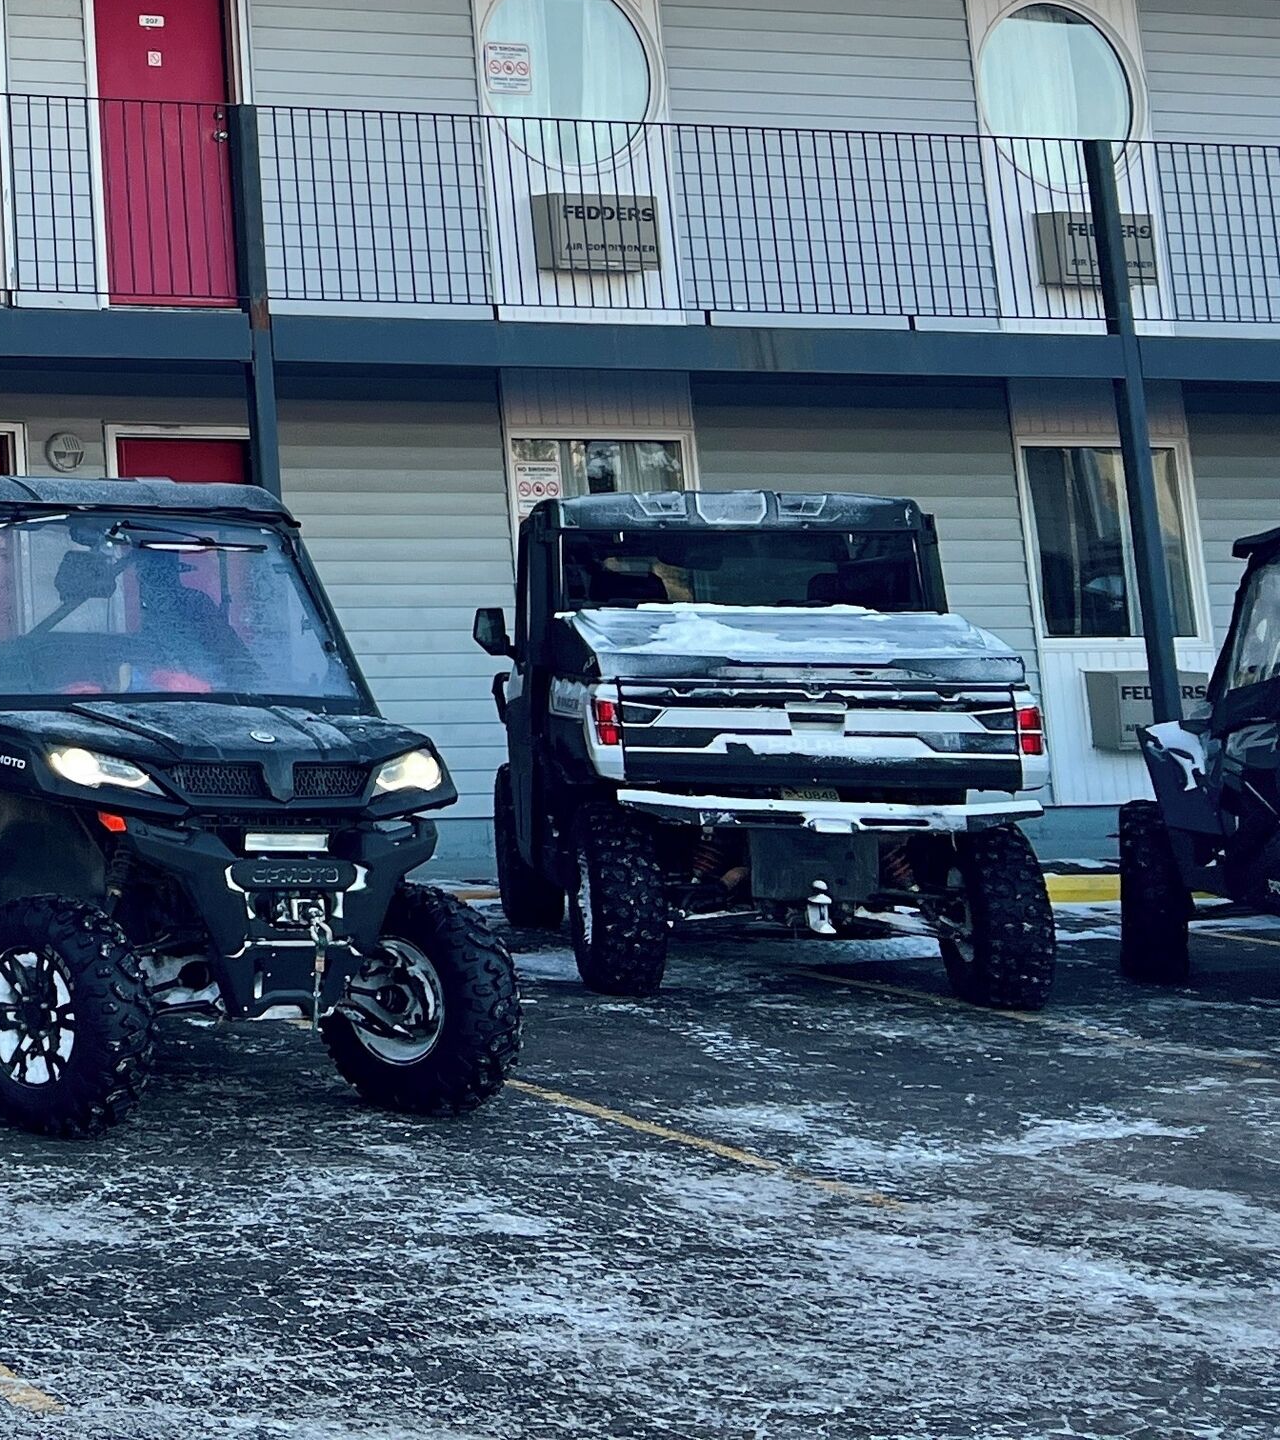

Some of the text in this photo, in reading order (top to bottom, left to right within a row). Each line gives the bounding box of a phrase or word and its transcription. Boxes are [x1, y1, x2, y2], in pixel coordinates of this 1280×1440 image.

[563, 205, 655, 222] FEDDERS
[565, 242, 656, 253] AIR CONDITIONER
